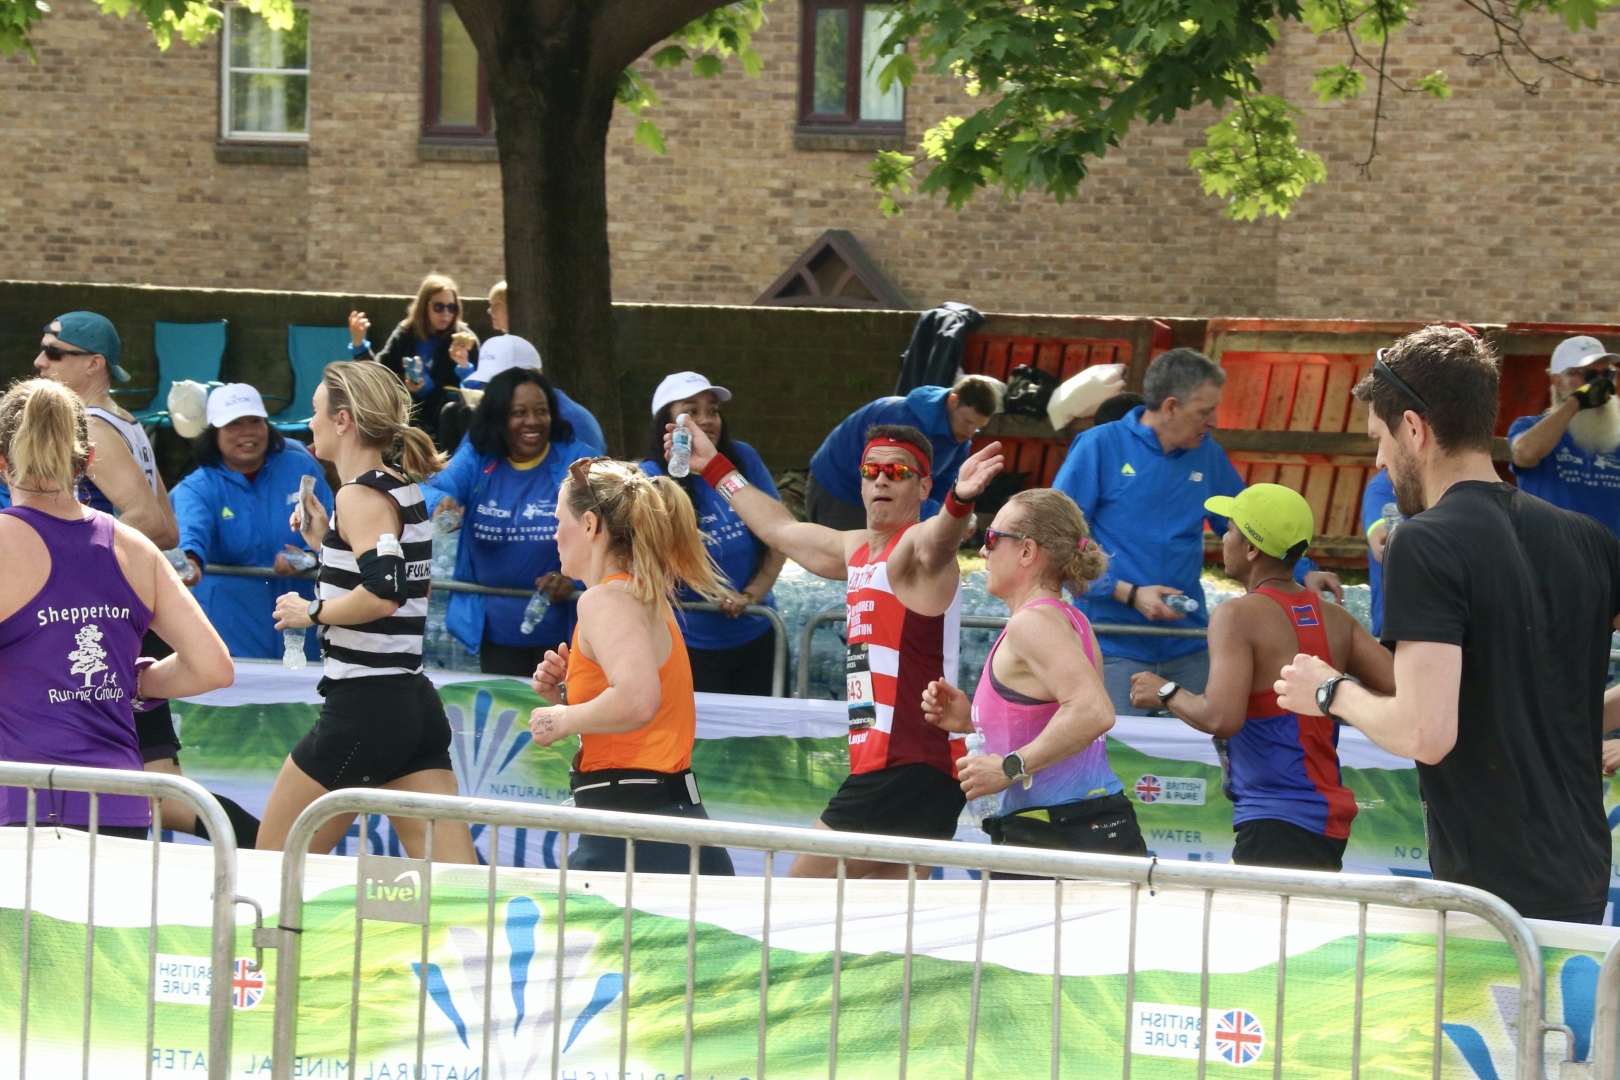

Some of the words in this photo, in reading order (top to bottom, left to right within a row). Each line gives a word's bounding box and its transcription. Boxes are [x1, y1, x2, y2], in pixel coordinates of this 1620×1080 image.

[473, 523, 502, 533] PROUD
[1244, 522, 1264, 544] CAMBODIA
[475, 532, 503, 541] SWEAT
[37, 604, 130, 626] Shepperton
[94, 686, 124, 703] Group
[490, 783, 551, 799] NATURAL
[1166, 781, 1201, 791] BRITISH
[1166, 791, 1171, 799] &
[1174, 791, 1198, 800] PURE
[1151, 829, 1202, 843] WATER
